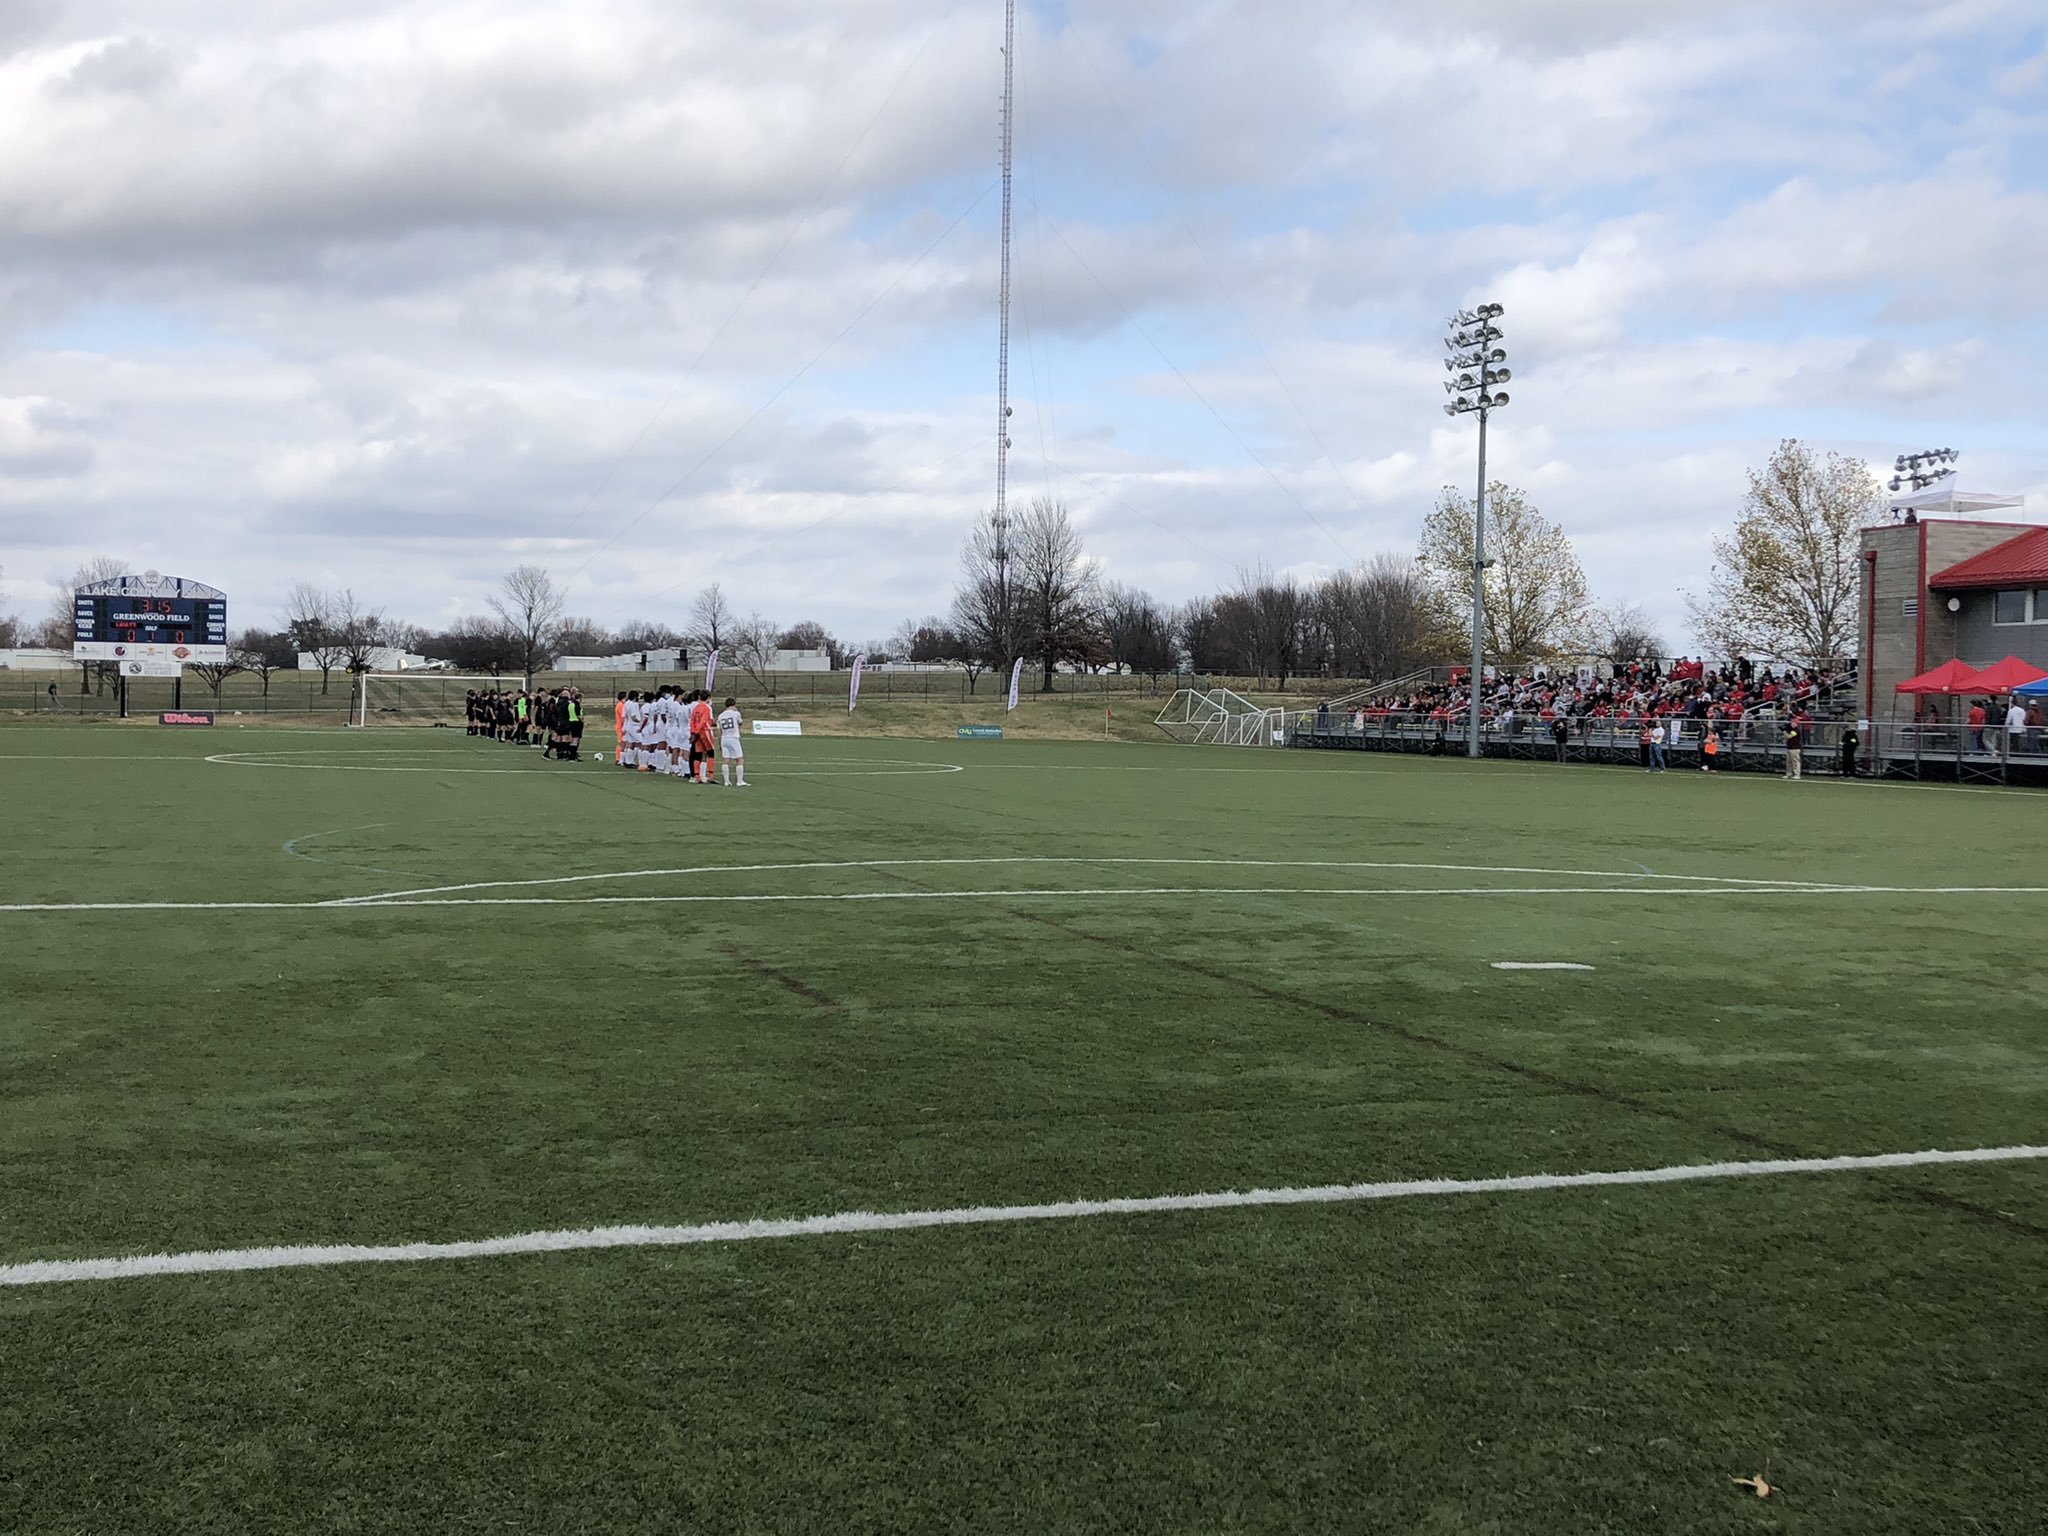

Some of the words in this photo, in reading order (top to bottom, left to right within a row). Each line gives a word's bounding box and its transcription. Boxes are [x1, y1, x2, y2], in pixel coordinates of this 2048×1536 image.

[83, 587, 117, 596] LAKE
[113, 613, 165, 622] GREENWOOD
[167, 614, 190, 622] FIELD
[127, 629, 136, 642] 0
[176, 631, 184, 643] 0
[164, 713, 209, 724] Wilson
[721, 717, 735, 730] 28
